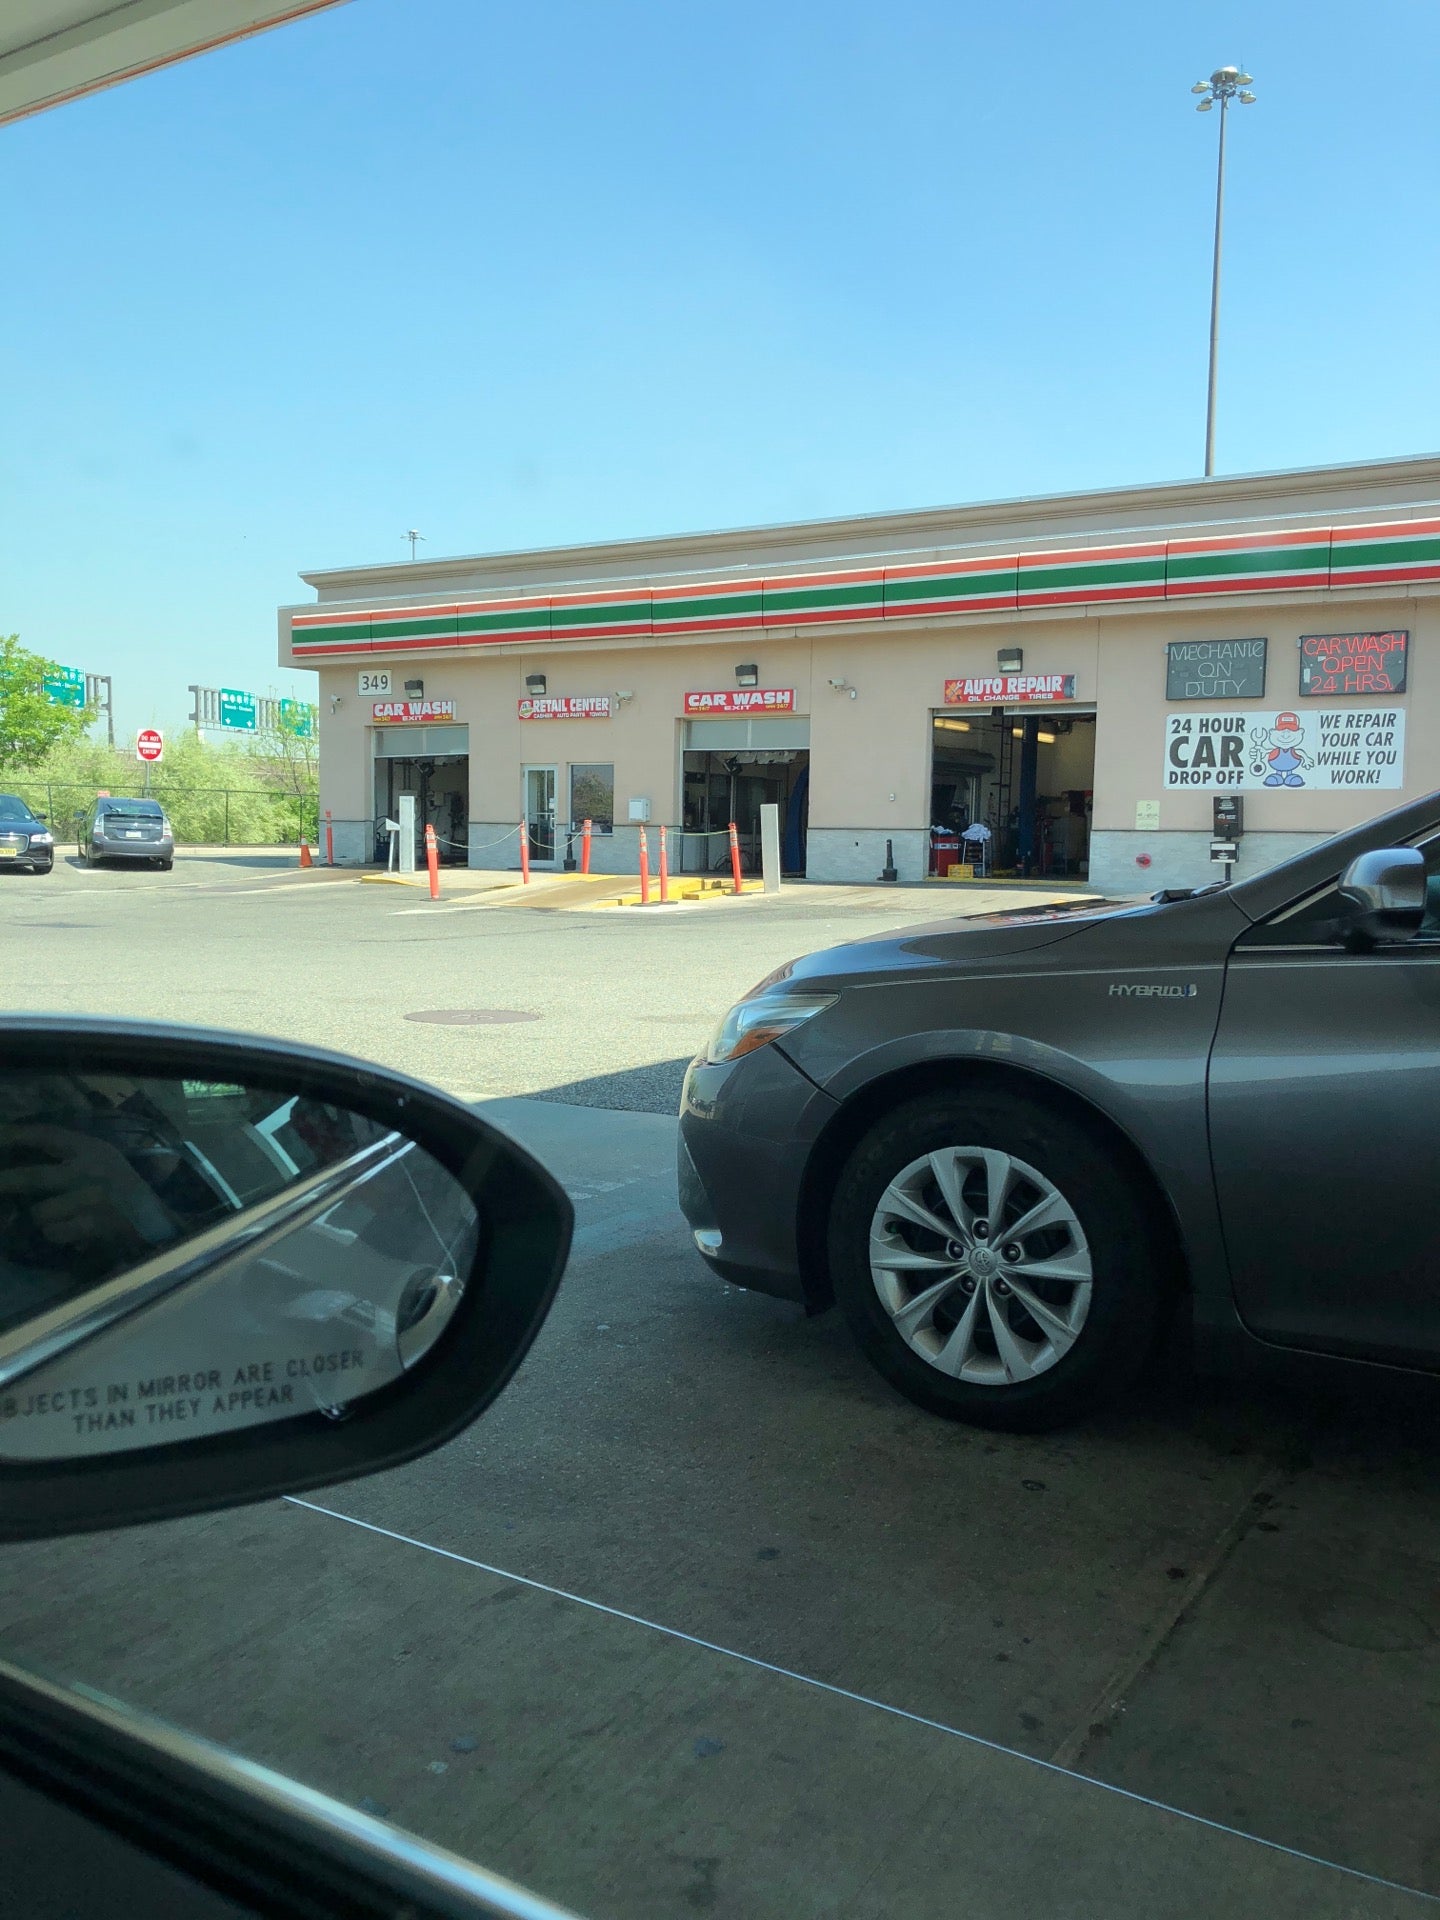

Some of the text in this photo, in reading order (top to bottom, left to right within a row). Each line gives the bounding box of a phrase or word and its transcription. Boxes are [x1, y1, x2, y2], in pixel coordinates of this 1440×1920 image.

[1170, 641, 1264, 661] MECHANIC
[1304, 633, 1405, 656] CAR WASH
[1198, 661, 1232, 678] ON
[1322, 653, 1385, 673] OPEN
[362, 675, 388, 690] 349
[963, 675, 1062, 695] AUTO REPAIR
[1185, 678, 1247, 697] DUTY
[1311, 675, 1337, 693] 24
[688, 691, 790, 706] CAR WASH
[983, 693, 1020, 701] CHANGE
[1028, 692, 1054, 700] TIRES
[374, 701, 452, 716] CAR WASH
[533, 700, 568, 712] RETAIL
[569, 698, 609, 711] CENTER
[1171, 717, 1246, 734] 24 HOUR
[1320, 713, 1397, 729] WE REPAIR
[1321, 732, 1394, 747] YOUR CAR
[1169, 735, 1244, 768] CAR
[1317, 750, 1397, 765] WHILE YOU
[1169, 771, 1244, 785] DROP OFF
[1331, 769, 1381, 785] WORK!
[1108, 984, 1182, 997] HYBRID
[0, 1350, 365, 1419] BJECTS IN MIRROR ARE CLOSER
[73, 1384, 296, 1434] THAN THEY APPEAR
